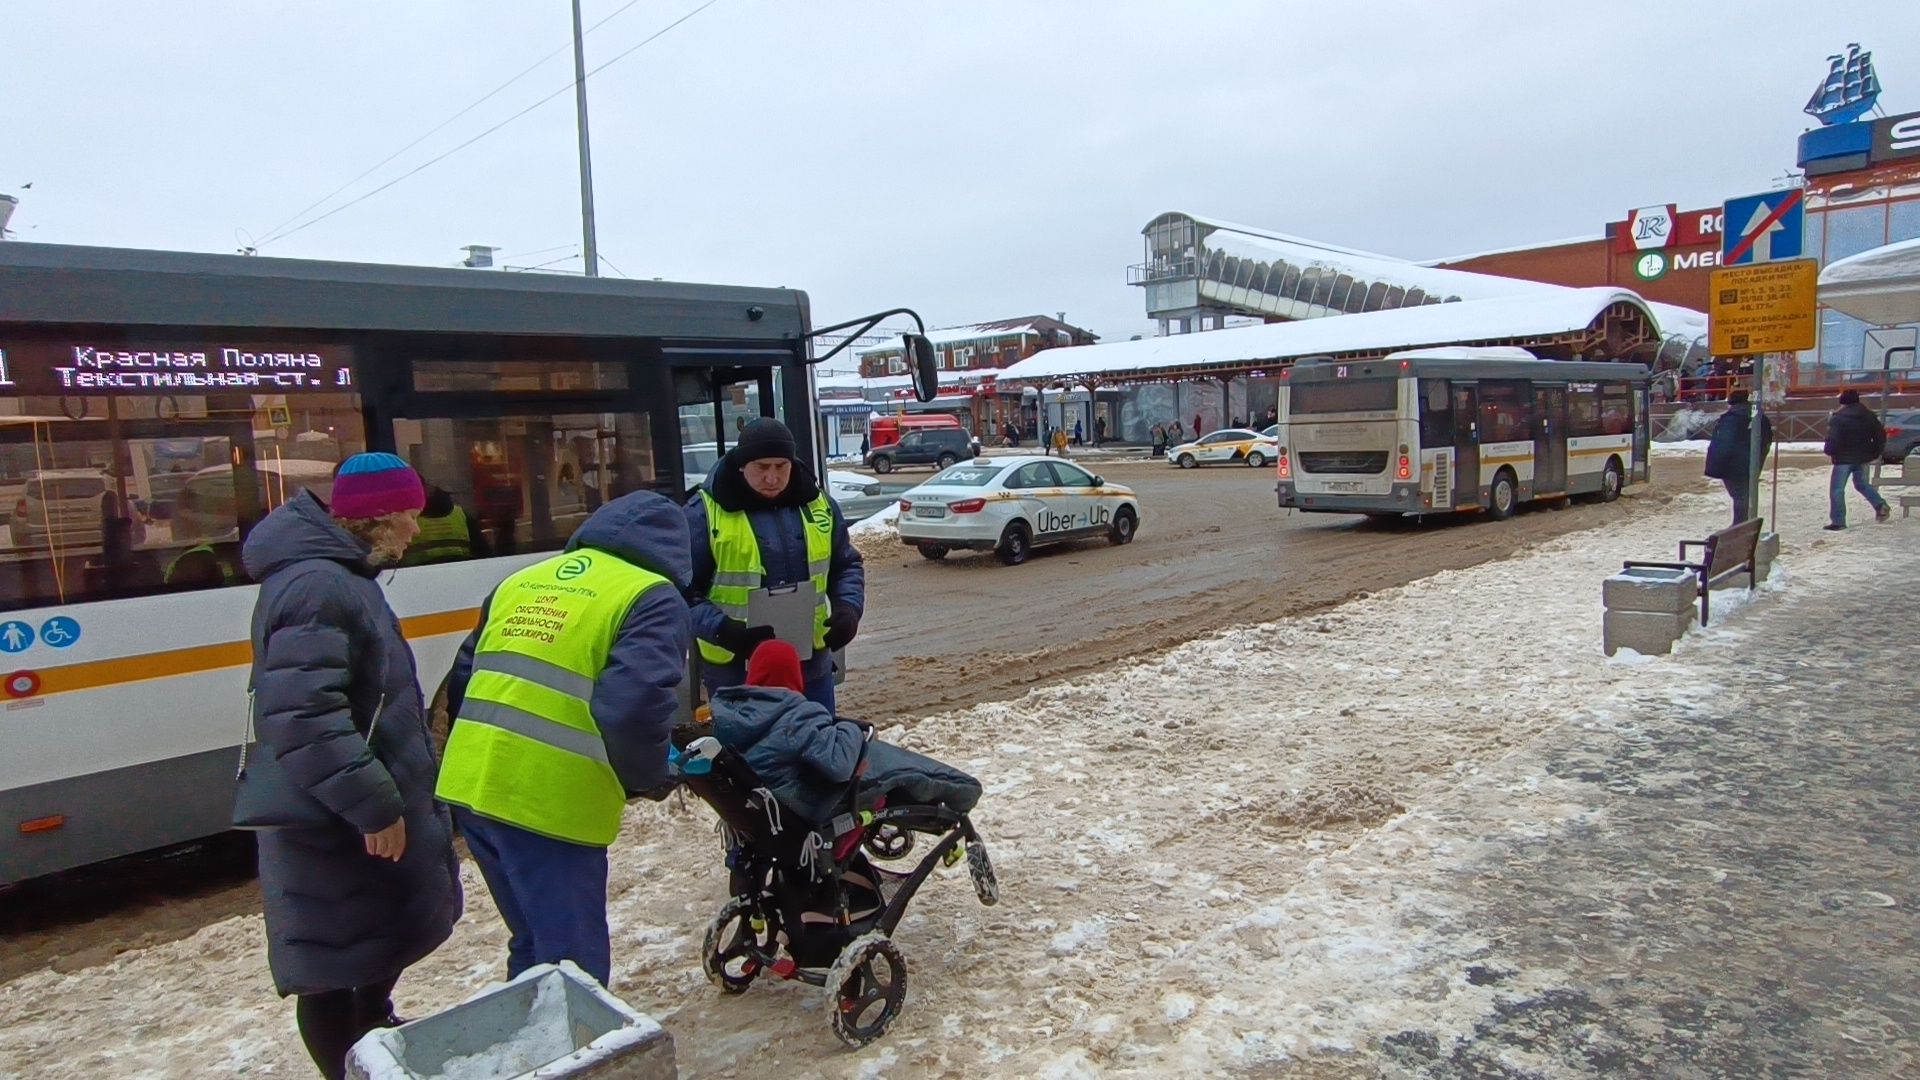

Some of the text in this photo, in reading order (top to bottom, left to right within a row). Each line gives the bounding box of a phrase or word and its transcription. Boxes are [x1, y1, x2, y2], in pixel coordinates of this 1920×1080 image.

[73, 346, 322, 369] Красная Поляна
[1336, 365, 1348, 377] 21
[940, 470, 984, 481] Uber
[1038, 505, 1109, 532] Uber Ub
[534, 595, 559, 604] ЦЕНТР
[501, 628, 556, 643] ПАССАЖИРОВ
